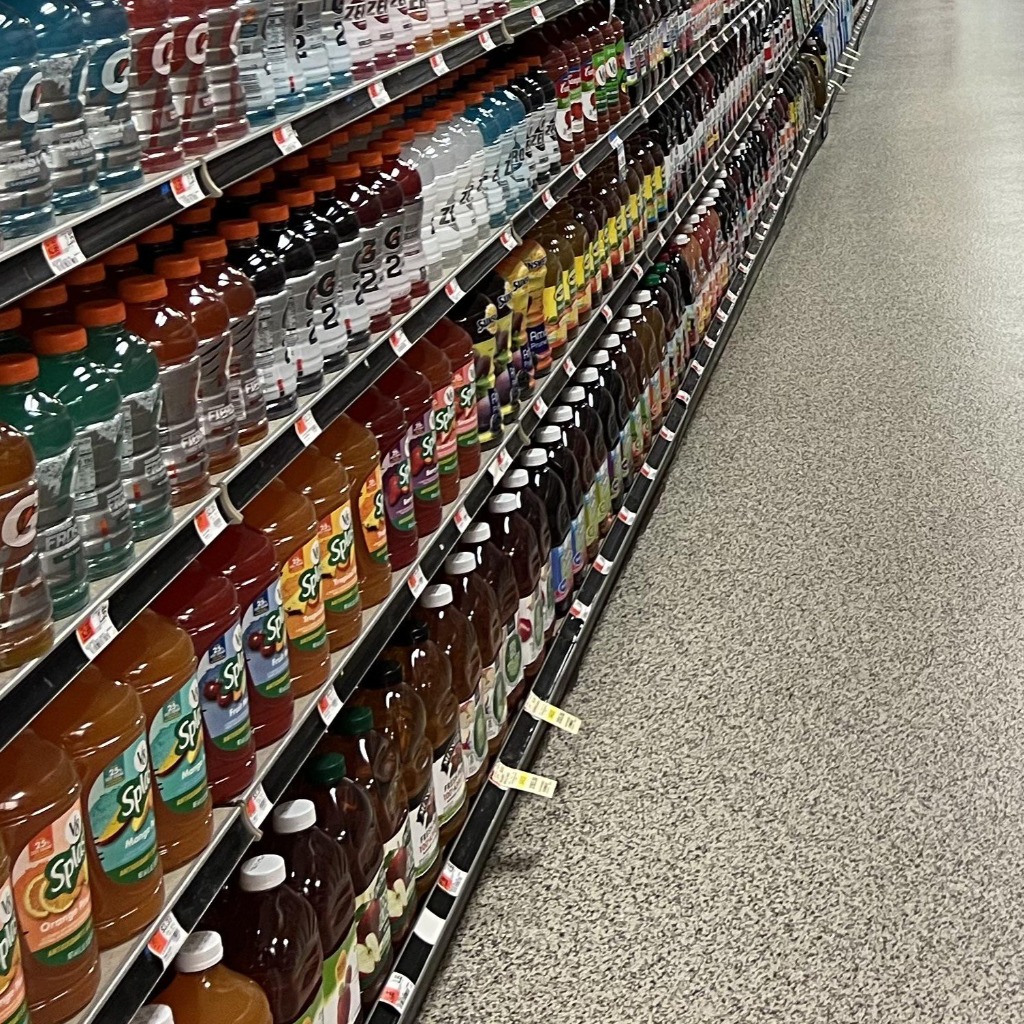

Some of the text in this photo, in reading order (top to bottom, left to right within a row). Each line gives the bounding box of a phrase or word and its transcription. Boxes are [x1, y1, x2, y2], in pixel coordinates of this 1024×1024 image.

[102, 47, 130, 95] G
[385, 226, 400, 249] G
[385, 254, 402, 278] 2
[317, 270, 335, 297] G
[361, 269, 379, 293] 2
[322, 303, 339, 330] 2
[2, 489, 38, 548] G
[40, 908, 79, 933] Orange
